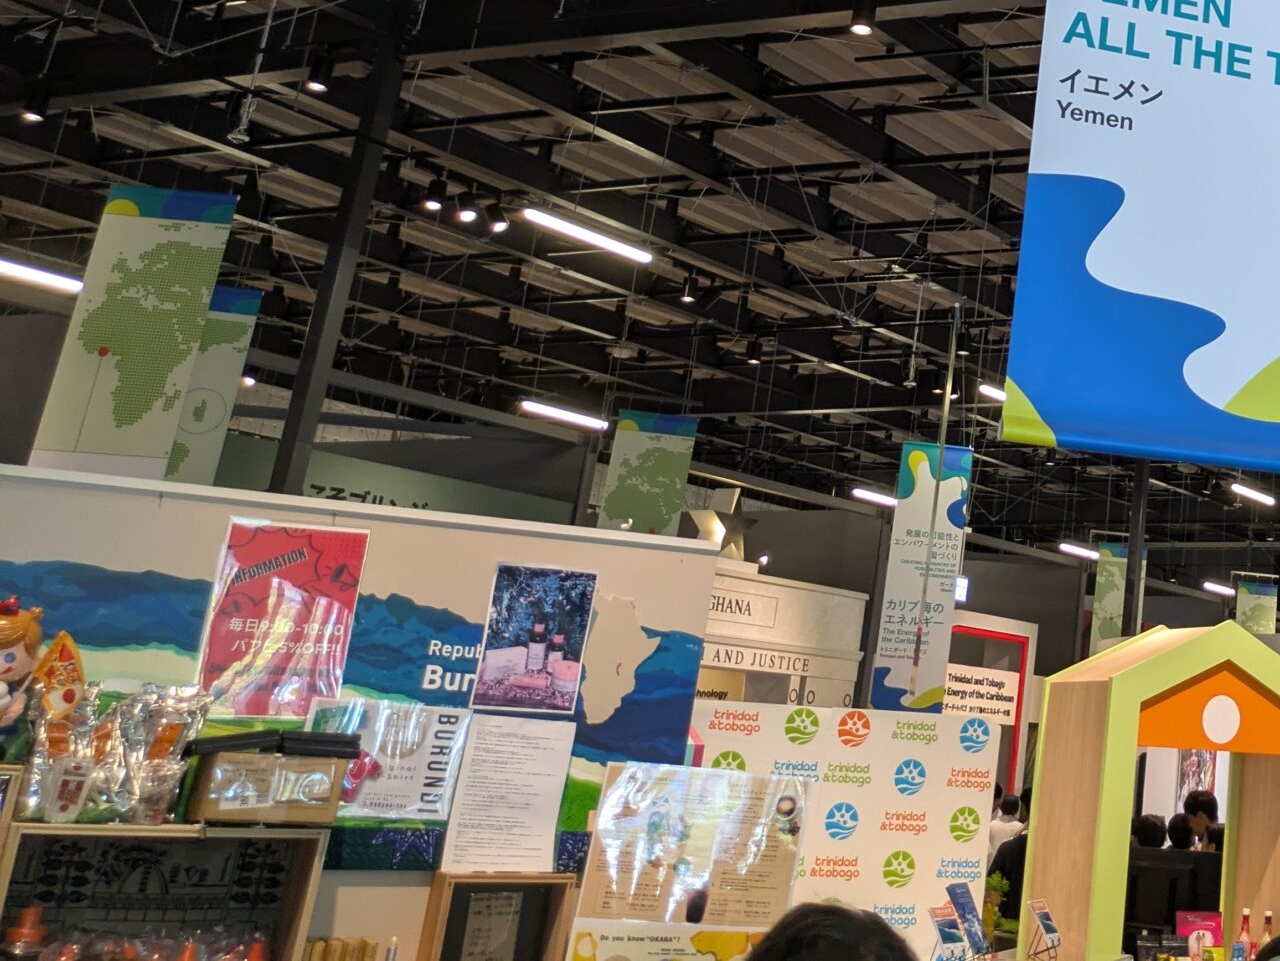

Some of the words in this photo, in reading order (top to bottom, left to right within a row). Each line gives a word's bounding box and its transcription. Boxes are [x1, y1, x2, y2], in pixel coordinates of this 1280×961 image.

[1062, 11, 1151, 60] ALL
[1165, 28, 1253, 80] THE
[1058, 68, 1164, 106] イエメン
[1055, 99, 1134, 131] Yemen
[232, 547, 309, 585] INFORMATION
[712, 648, 744, 665] AND
[751, 652, 810, 672] JUSTICE
[948, 673, 973, 685] Trinidad
[973, 677, 985, 686] and
[985, 678, 1006, 690] Tobago
[947, 687, 968, 700] Energy
[968, 689, 976, 698] of
[985, 691, 1015, 703] Caribbean
[714, 709, 760, 722] trinidad
[708, 722, 761, 736] &tobago
[896, 719, 937, 732] trinidad
[891, 731, 938, 745] &tobago
[417, 714, 459, 814] BURUNDI
[774, 759, 819, 772] trinidad
[828, 762, 870, 775] trinidad
[822, 772, 872, 787] &tobago
[951, 767, 990, 778] trinidad
[946, 778, 991, 792] &tobago
[885, 810, 926, 821] trinidad
[880, 821, 928, 835] &tobago
[815, 856, 859, 867] trinidad
[940, 858, 980, 869] trinidad
[810, 867, 860, 881] &tobago
[936, 869, 981, 882] &tobago
[874, 904, 915, 915] trinidad
